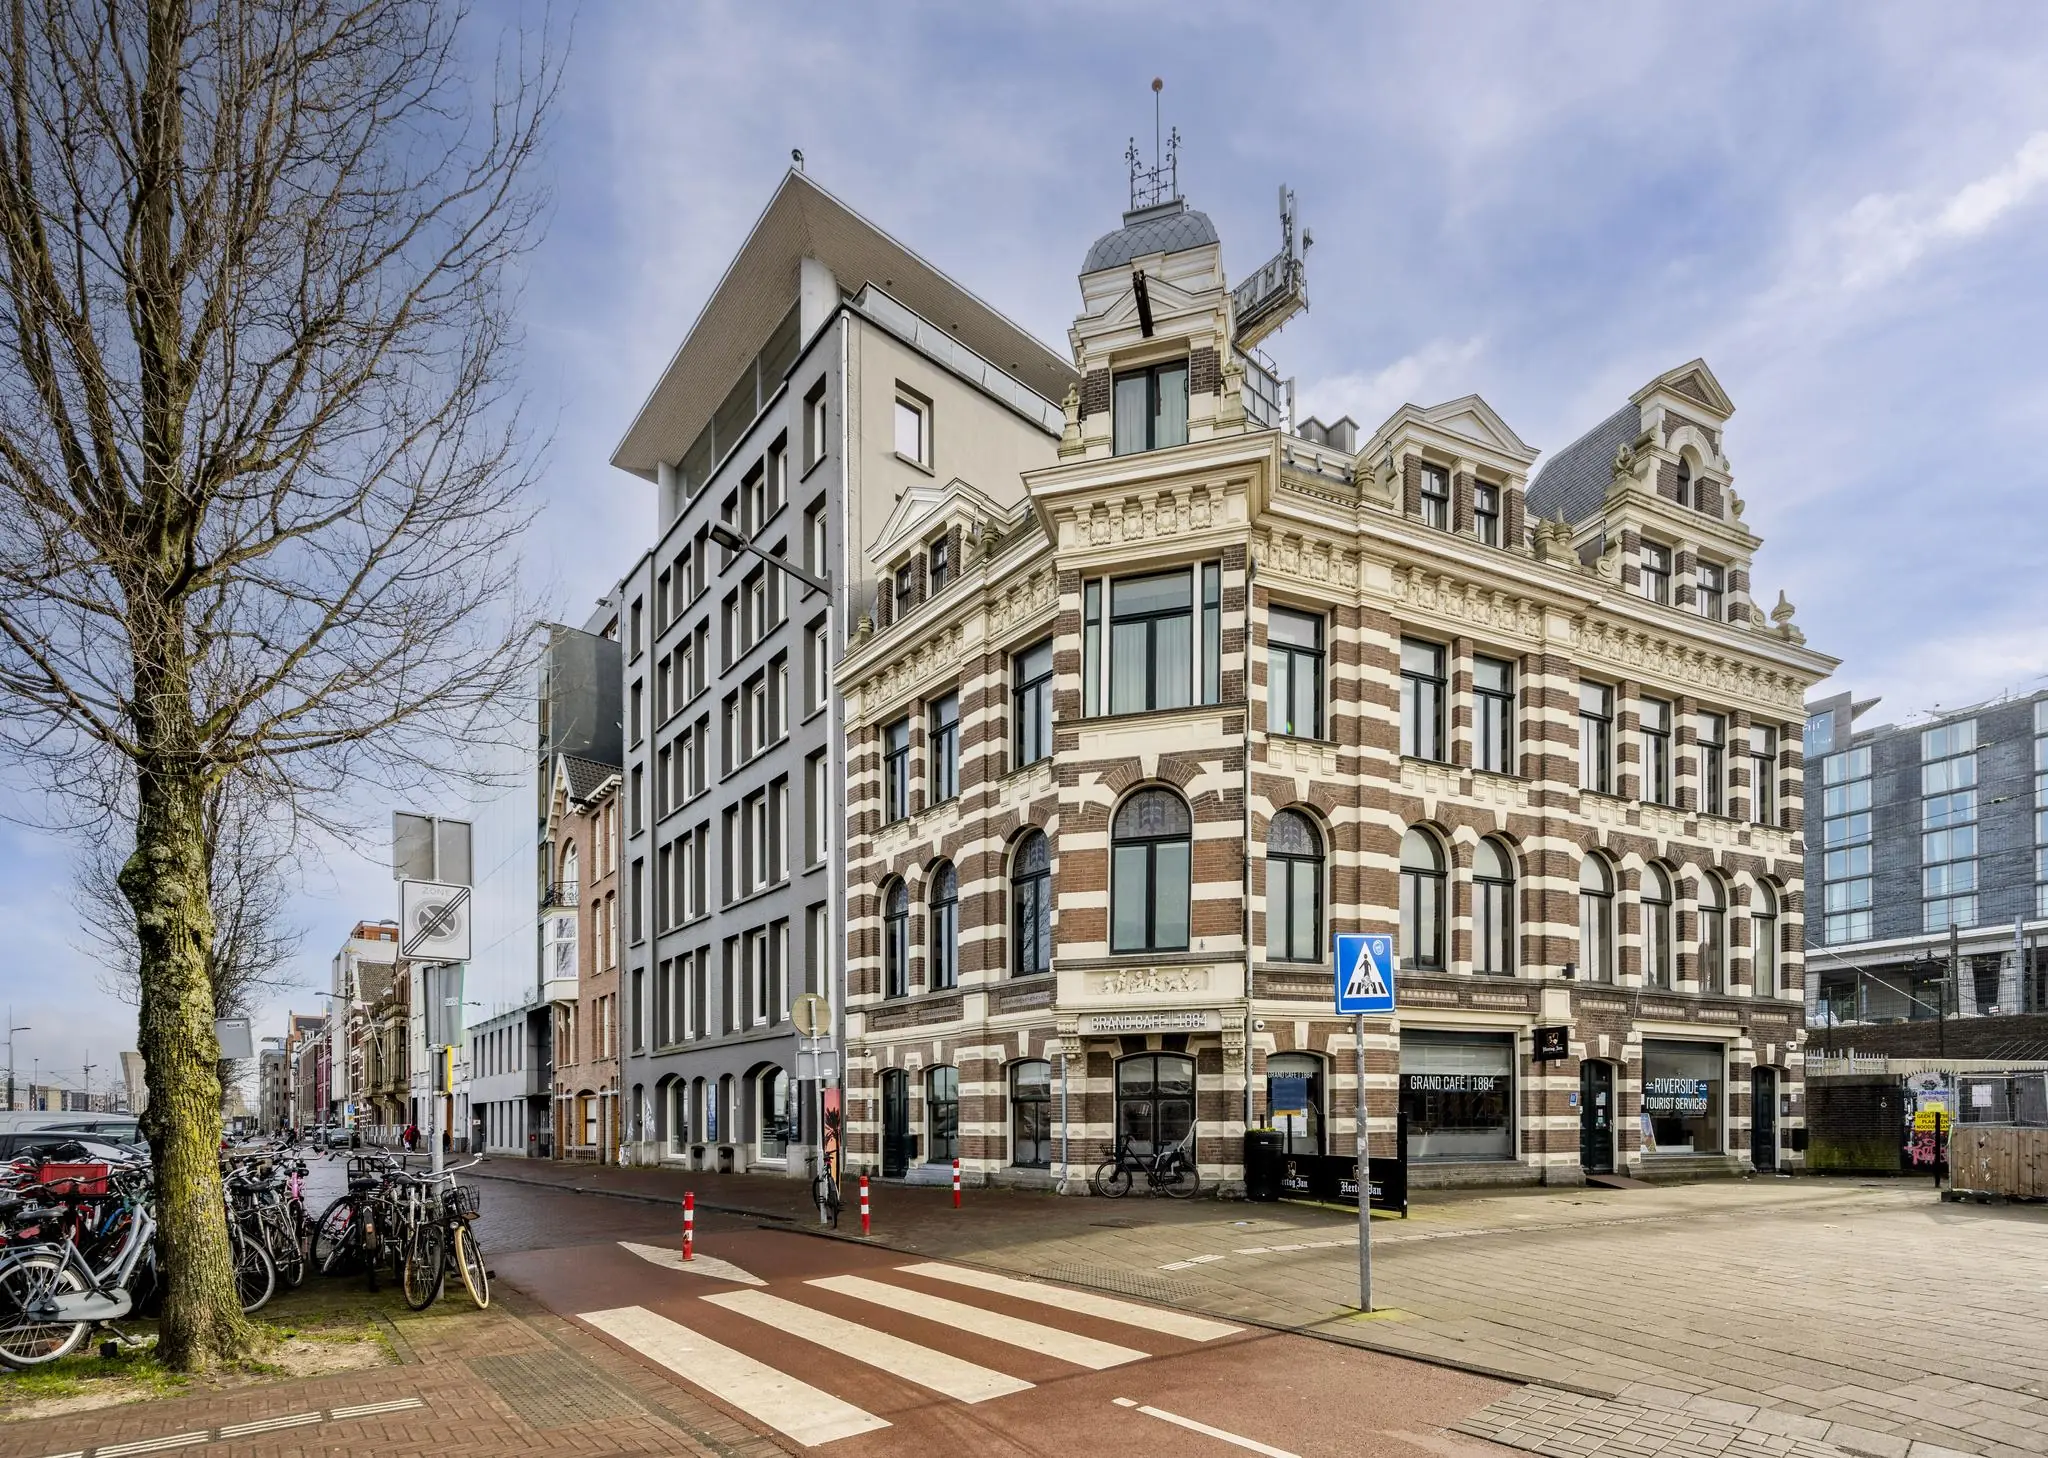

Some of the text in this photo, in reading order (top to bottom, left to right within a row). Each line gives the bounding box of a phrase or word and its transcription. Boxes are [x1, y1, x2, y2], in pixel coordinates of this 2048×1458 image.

[1091, 1015, 1131, 1031] GRAND
[1177, 1012, 1207, 1029] 1884
[1410, 1075, 1441, 1090] GRAND
[1472, 1076, 1494, 1091] 1884
[1654, 1077, 1699, 1094] RIVERSIDE
[1646, 1096, 1707, 1110] TOURIST SERVICES
[1296, 1177, 1308, 1190] Jan
[1340, 1180, 1359, 1195] Hert
